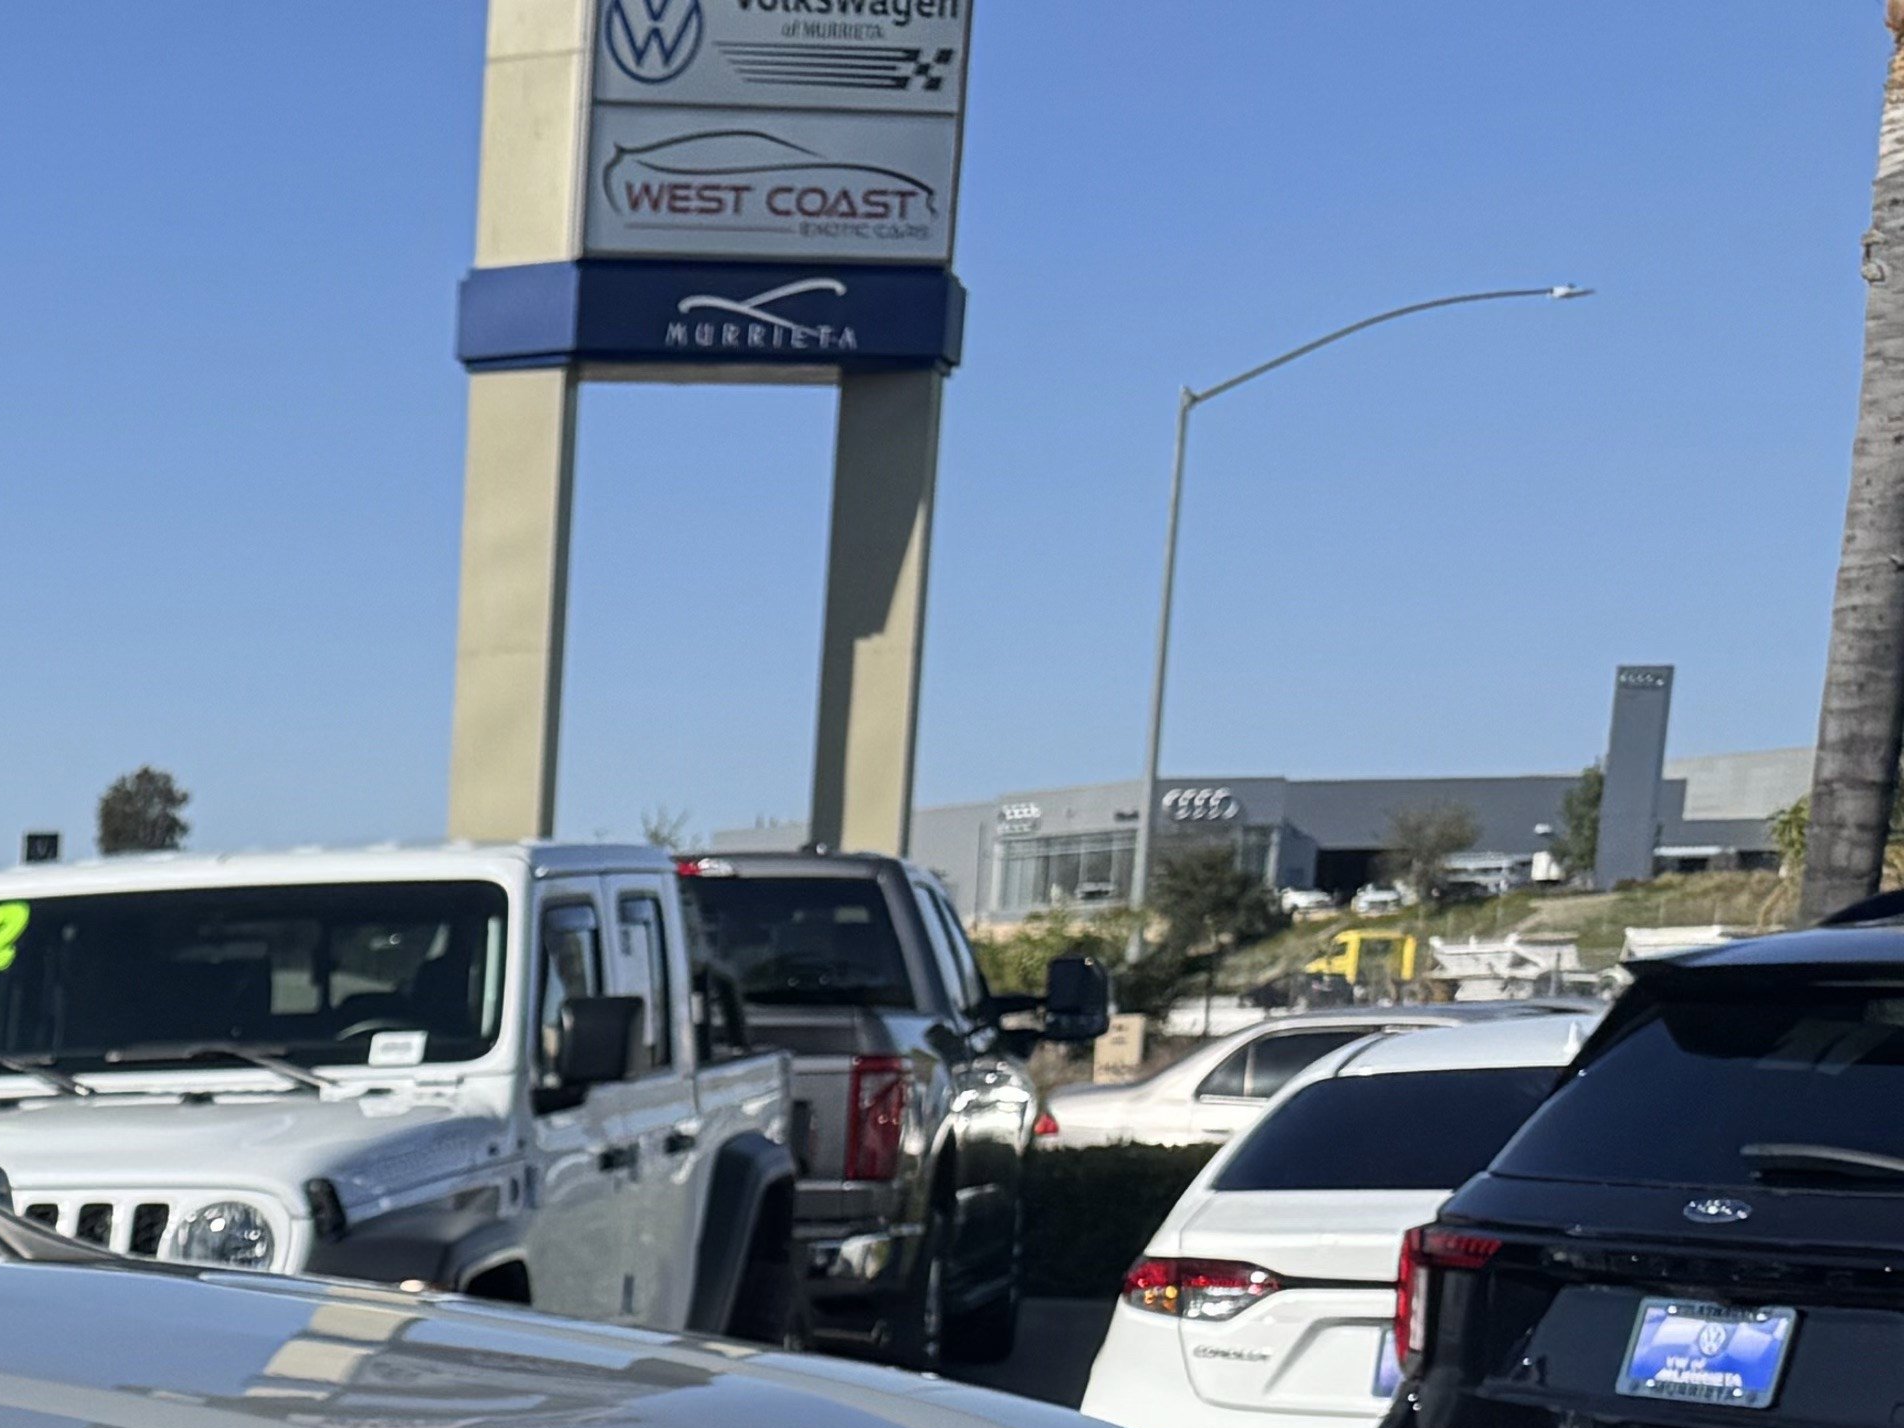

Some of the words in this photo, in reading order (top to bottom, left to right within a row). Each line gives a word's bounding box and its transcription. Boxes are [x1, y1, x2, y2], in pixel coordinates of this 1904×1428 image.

[624, 181, 754, 216] WEST
[765, 186, 920, 221] COAST
[664, 320, 859, 350] MURRIETA
